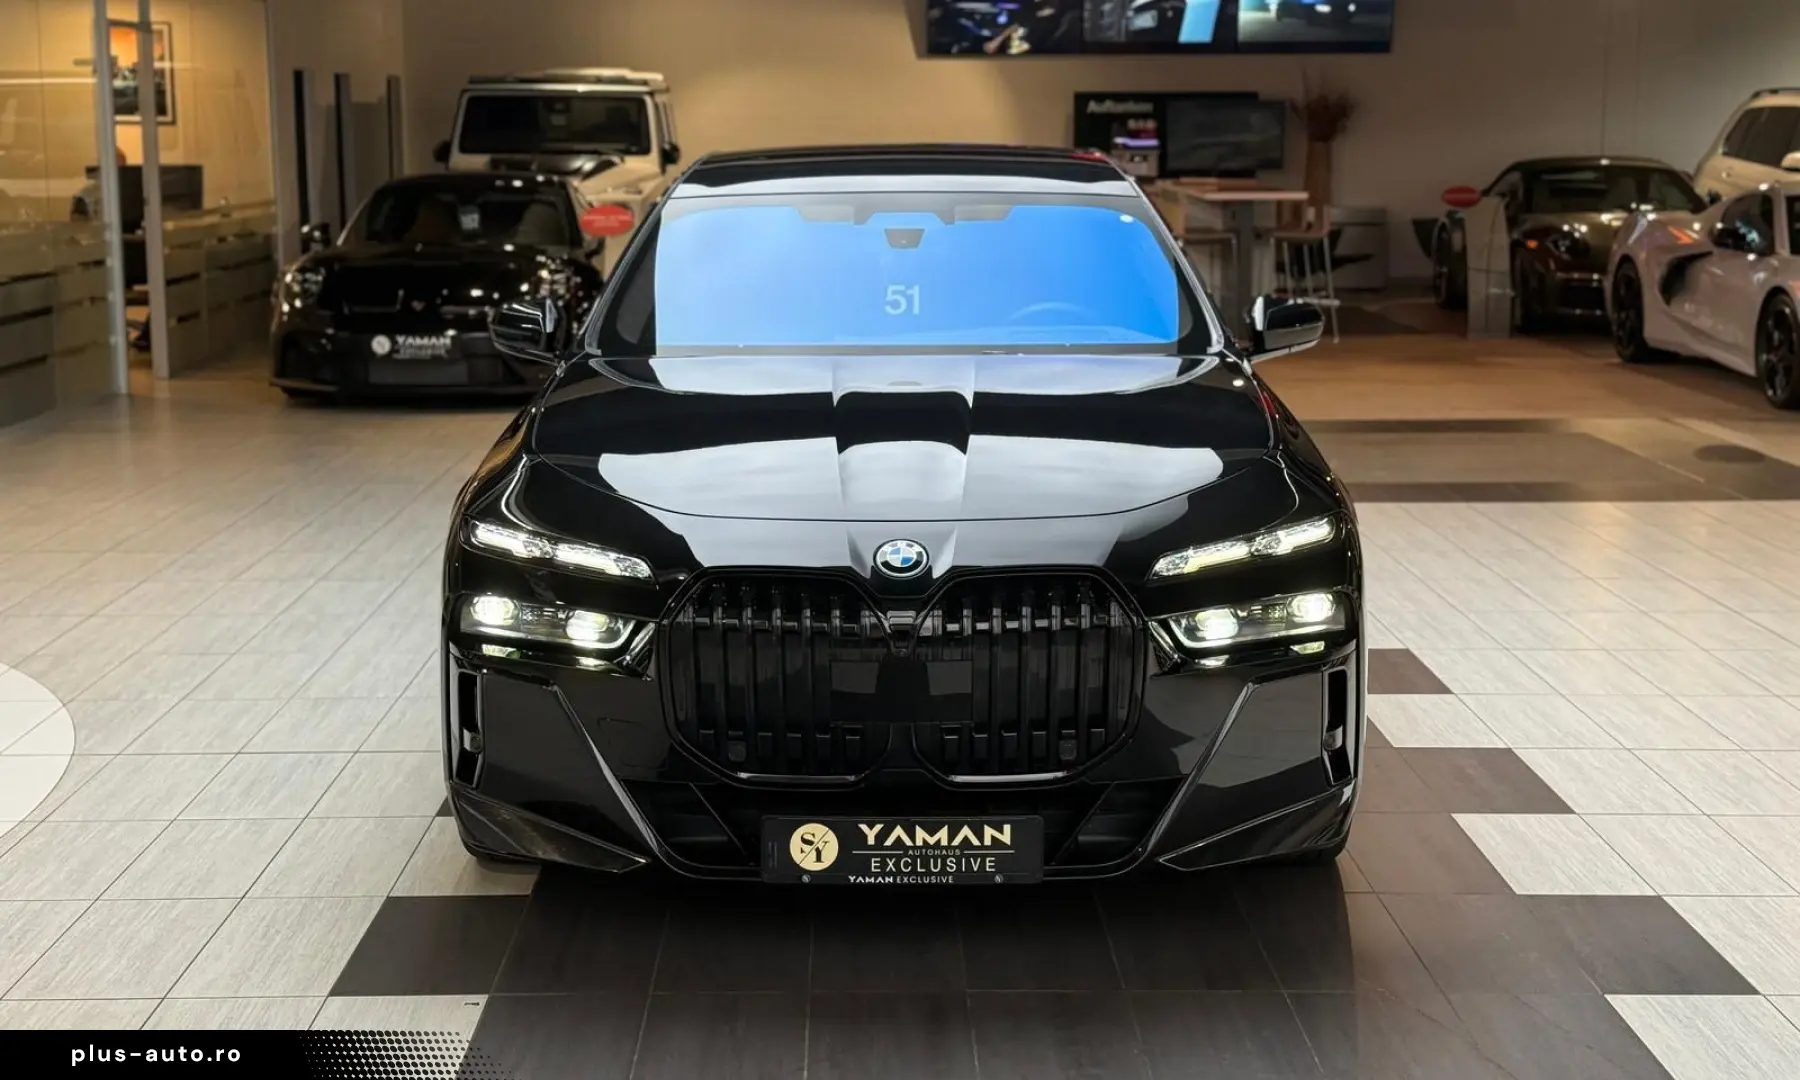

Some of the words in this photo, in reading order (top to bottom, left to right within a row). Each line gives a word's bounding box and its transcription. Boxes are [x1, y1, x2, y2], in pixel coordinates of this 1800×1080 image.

[884, 284, 920, 315] 51
[858, 824, 1012, 846] YAMAN
[908, 848, 961, 856] AUTOHAUS
[871, 857, 996, 872] EXCLUSIVE
[848, 875, 894, 884] YAMAN
[896, 875, 954, 884] EXCLUSIVE
